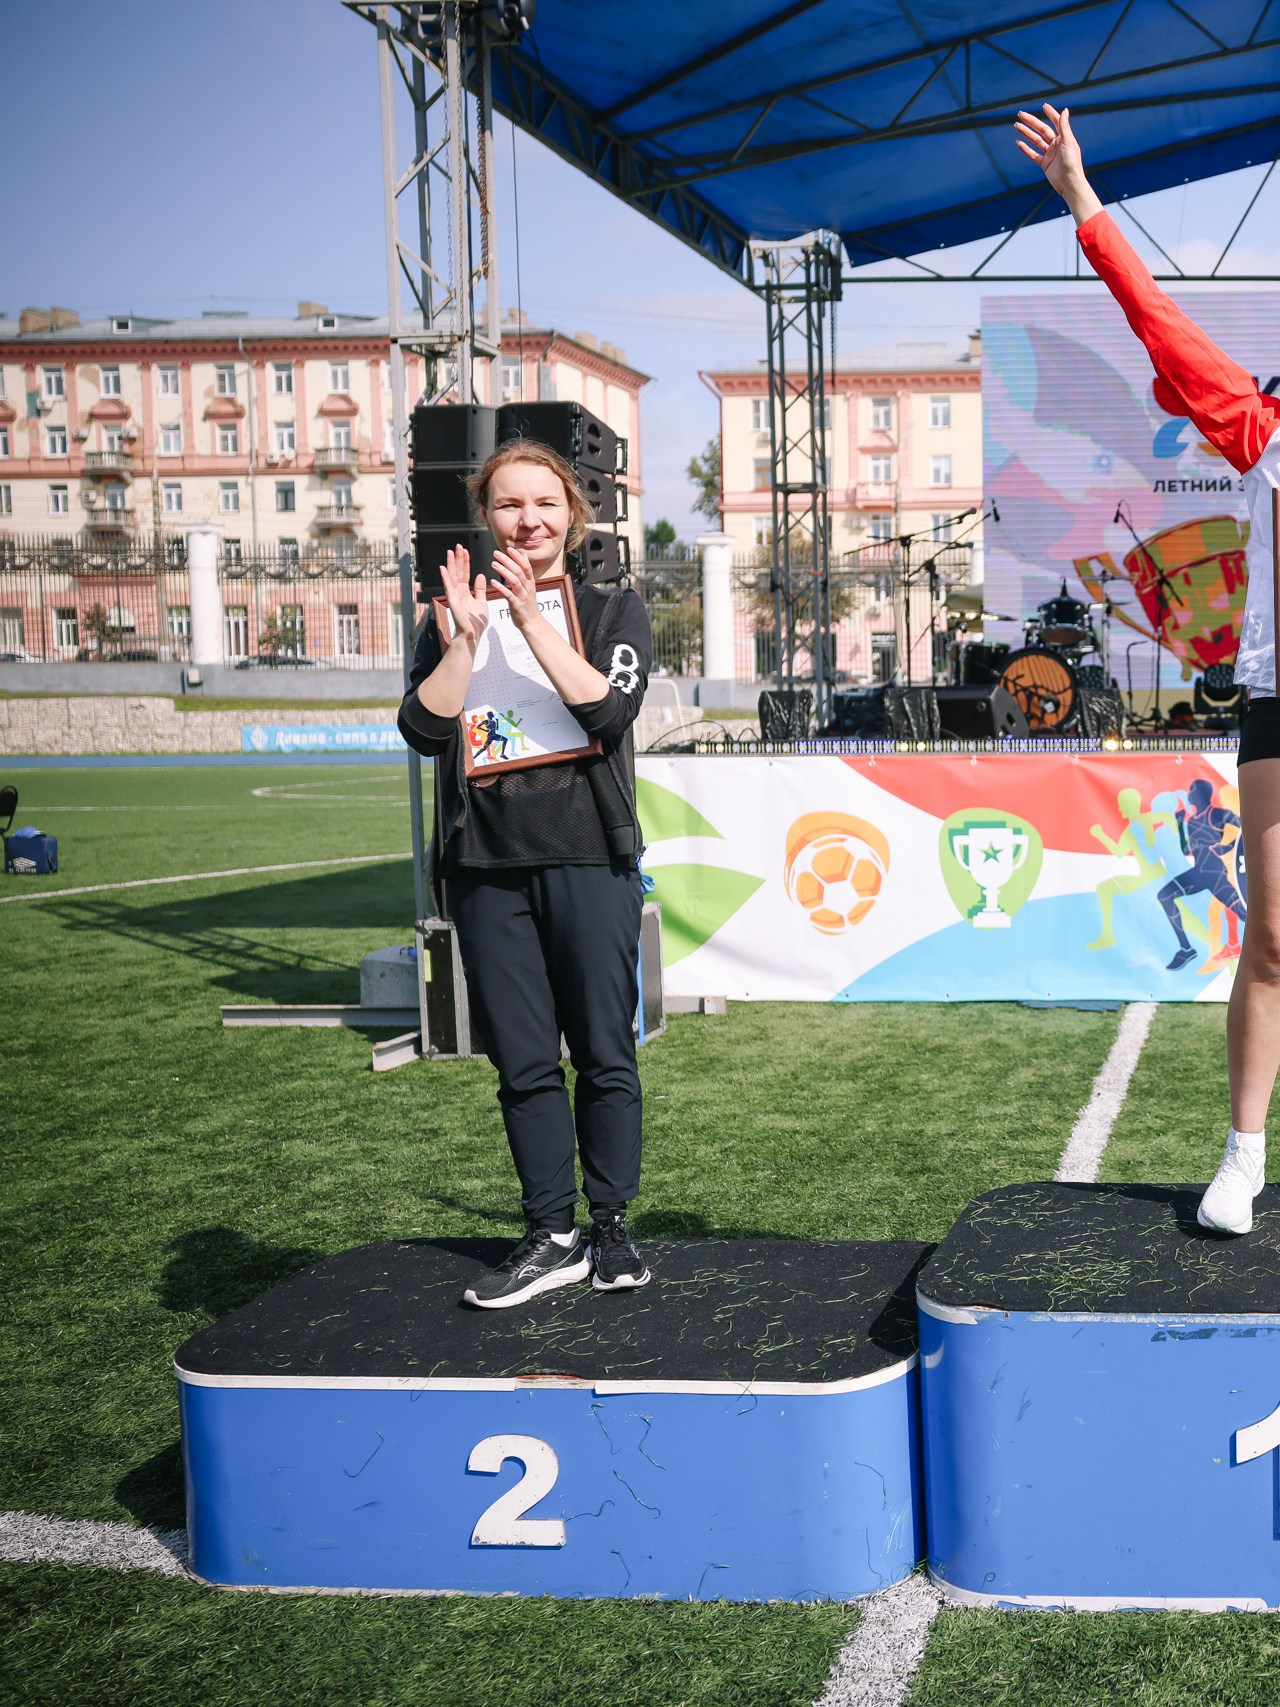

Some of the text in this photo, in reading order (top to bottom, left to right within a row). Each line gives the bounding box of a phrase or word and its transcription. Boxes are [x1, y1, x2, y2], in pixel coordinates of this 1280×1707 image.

[1153, 476, 1232, 493] ЛЕТНИЙ
[499, 600, 562, 620] ГРОТА
[467, 1434, 566, 1547] 2
